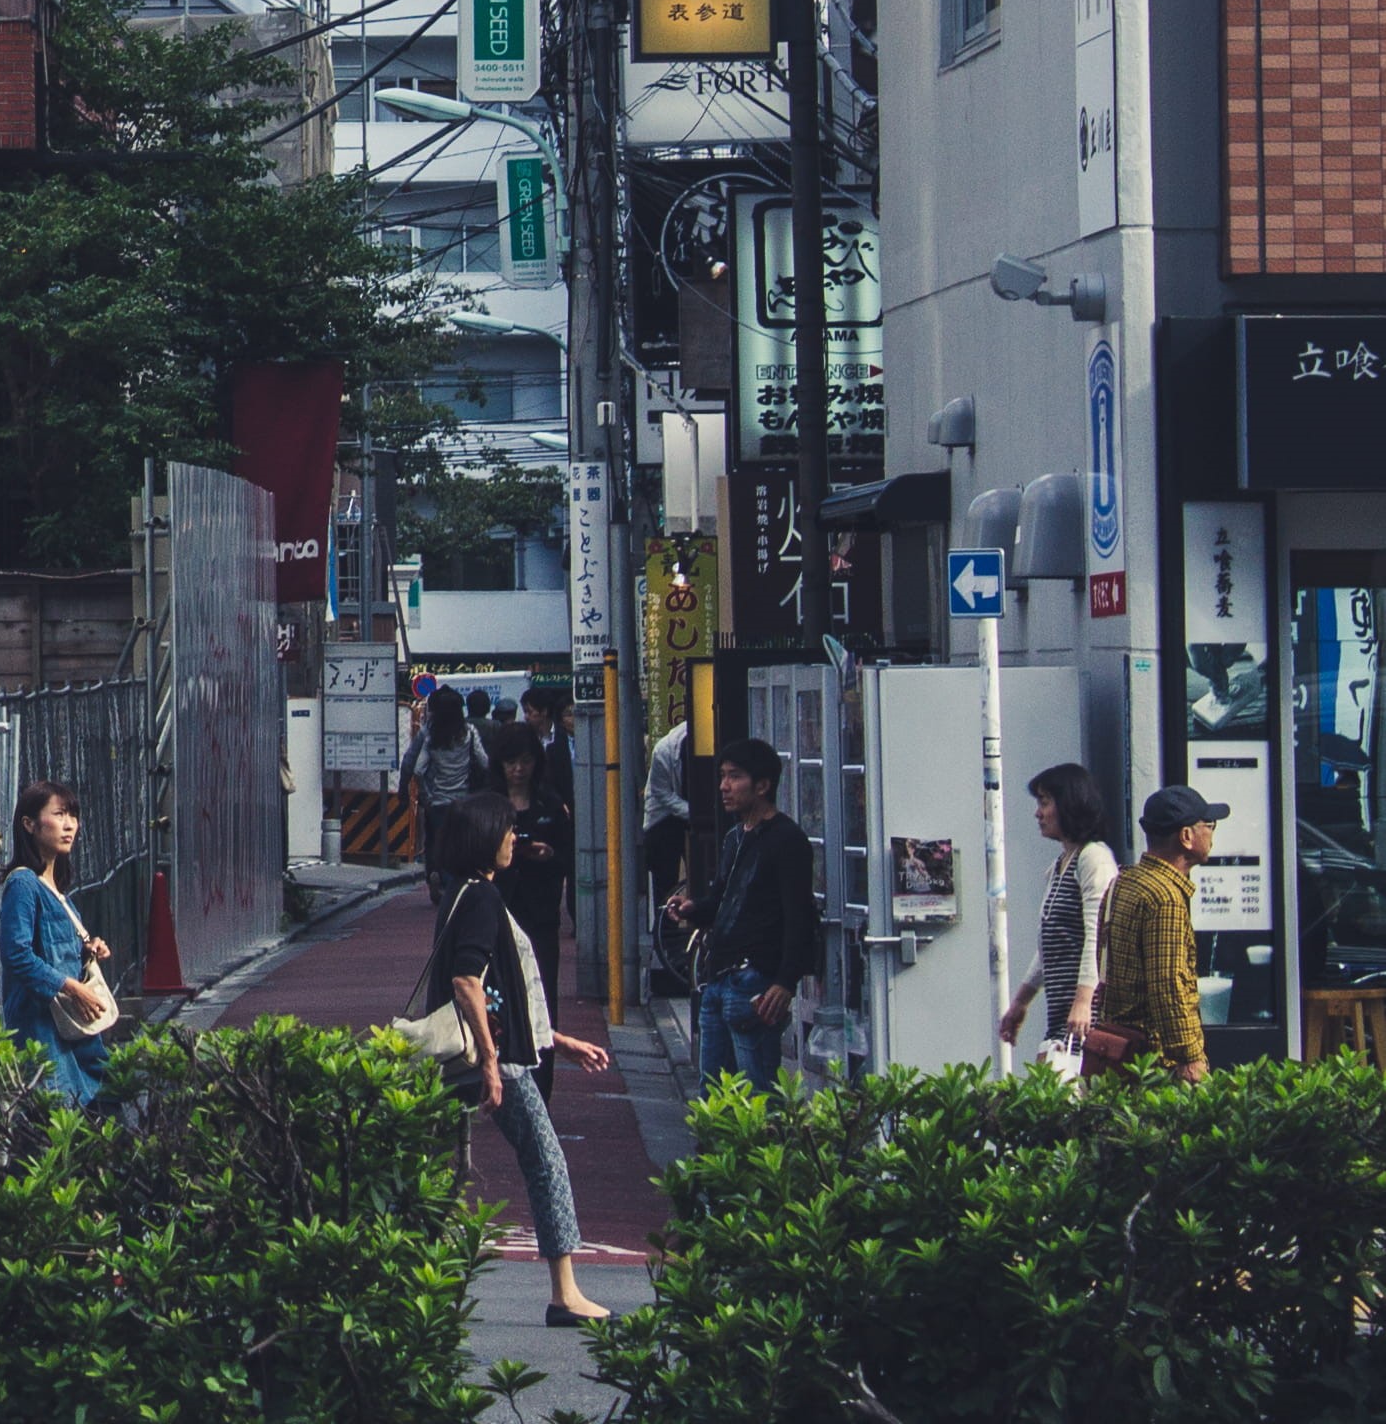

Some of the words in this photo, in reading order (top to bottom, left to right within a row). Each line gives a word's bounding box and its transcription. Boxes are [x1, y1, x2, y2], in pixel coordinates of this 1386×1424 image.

[667, 3, 745, 21] 表参道
[490, 7, 508, 56] SEED
[474, 63, 525, 72] 3400-5511
[518, 178, 534, 222] GREEN
[520, 222, 535, 257] SEED
[790, 330, 859, 342] AAMA
[756, 363, 868, 380] ENTNCE
[1293, 341, 1386, 380] 立喰
[587, 466, 601, 501] 茶器
[577, 508, 603, 629] ことぶきや
